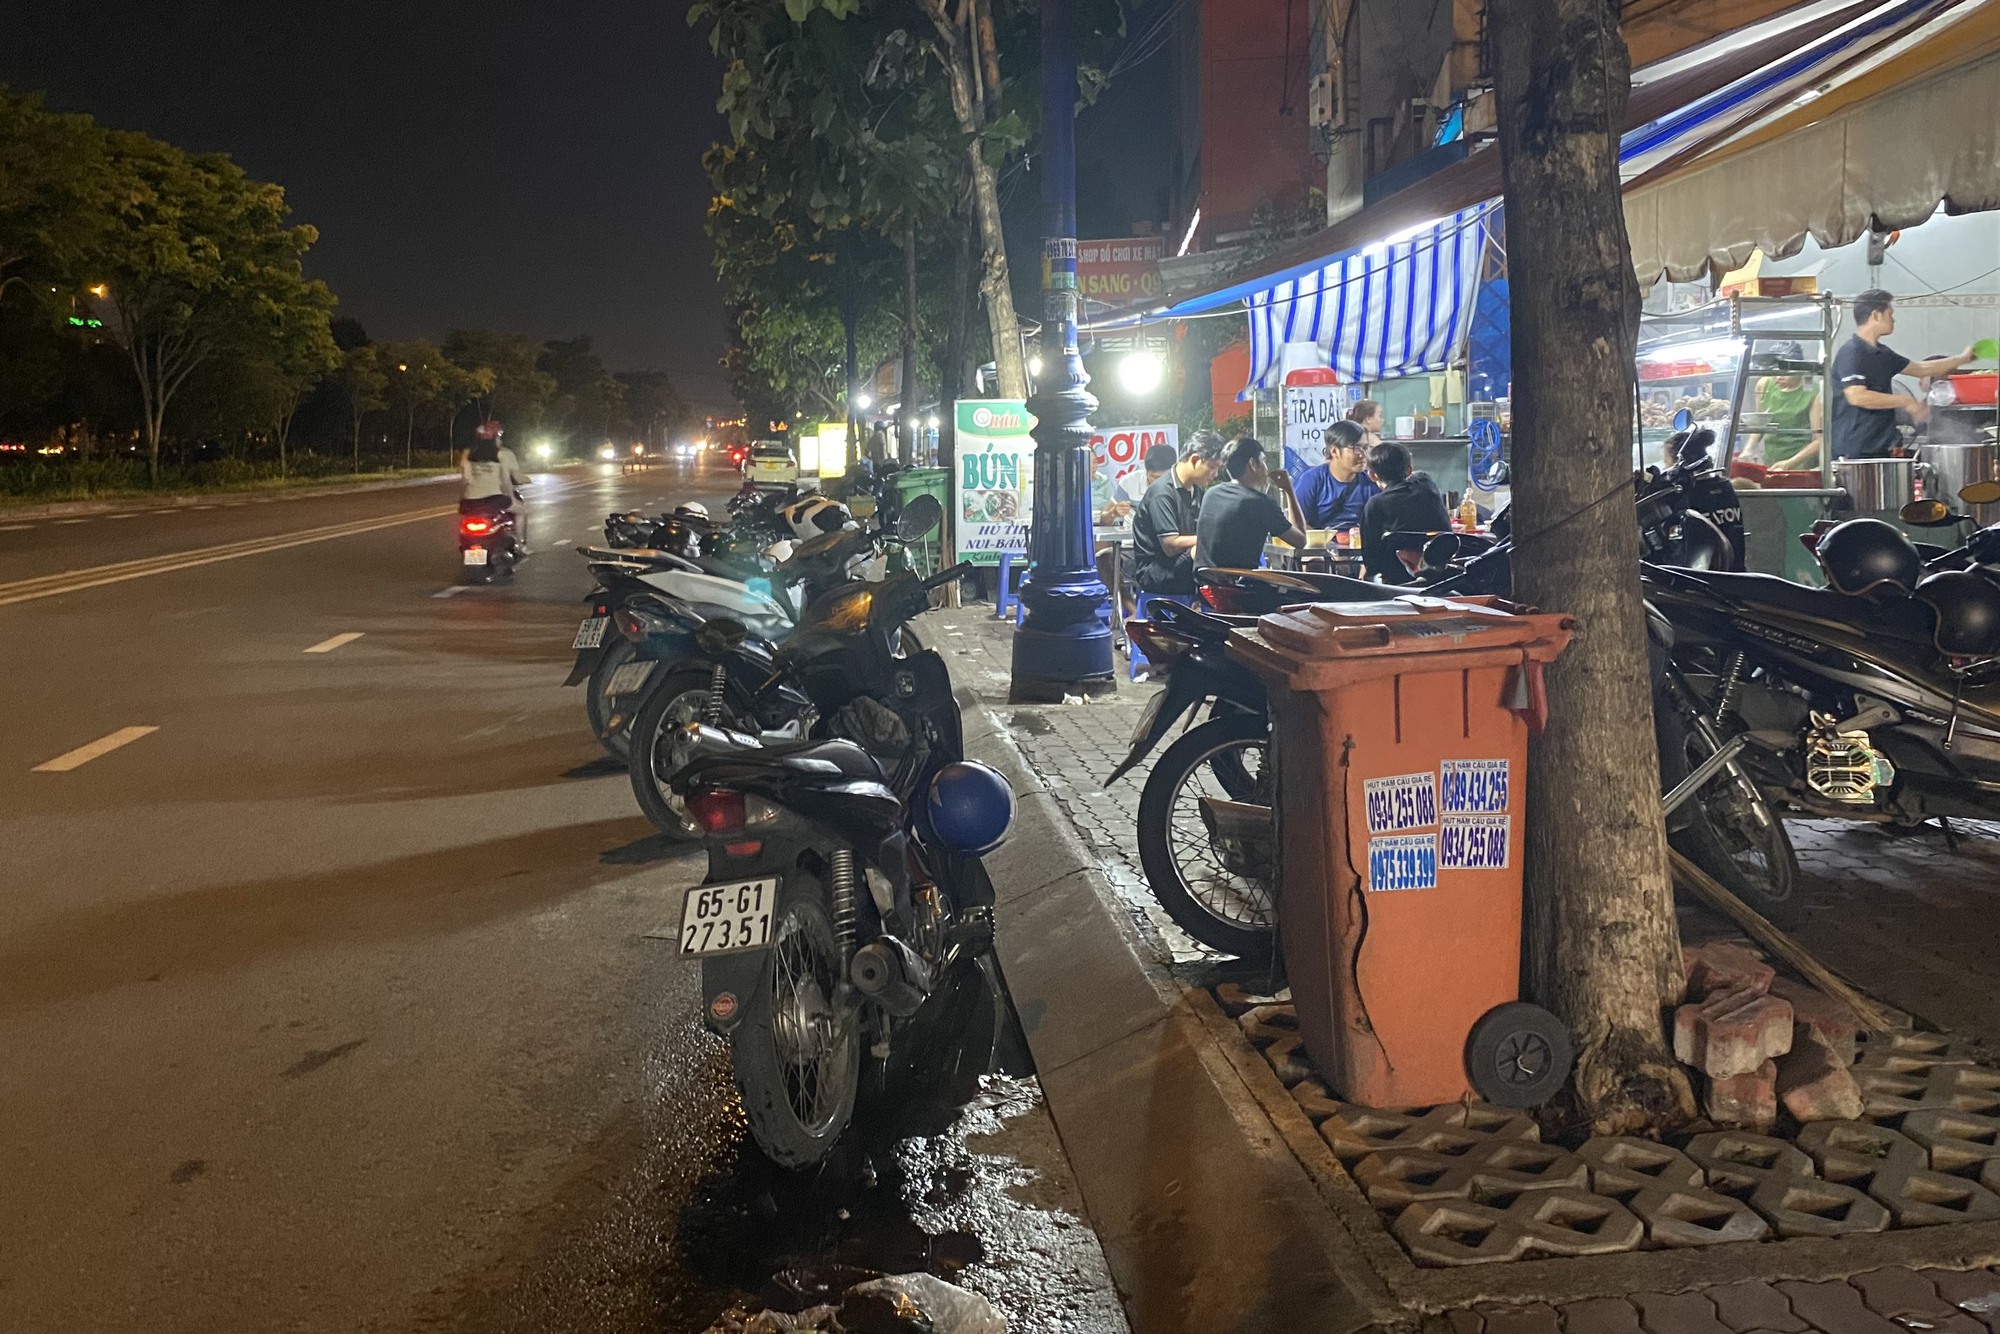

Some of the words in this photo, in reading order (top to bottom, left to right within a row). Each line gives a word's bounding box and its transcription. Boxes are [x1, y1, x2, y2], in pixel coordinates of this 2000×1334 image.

[1088, 273, 1130, 294] SANG
[1292, 392, 1316, 423] TRÀ
[962, 443, 1019, 490] BÚN
[1369, 785, 1435, 831] 0934.255.088
[1441, 826, 1506, 866] 0934.255.088
[697, 883, 763, 919] 65-G1
[683, 914, 769, 953] 273.51
